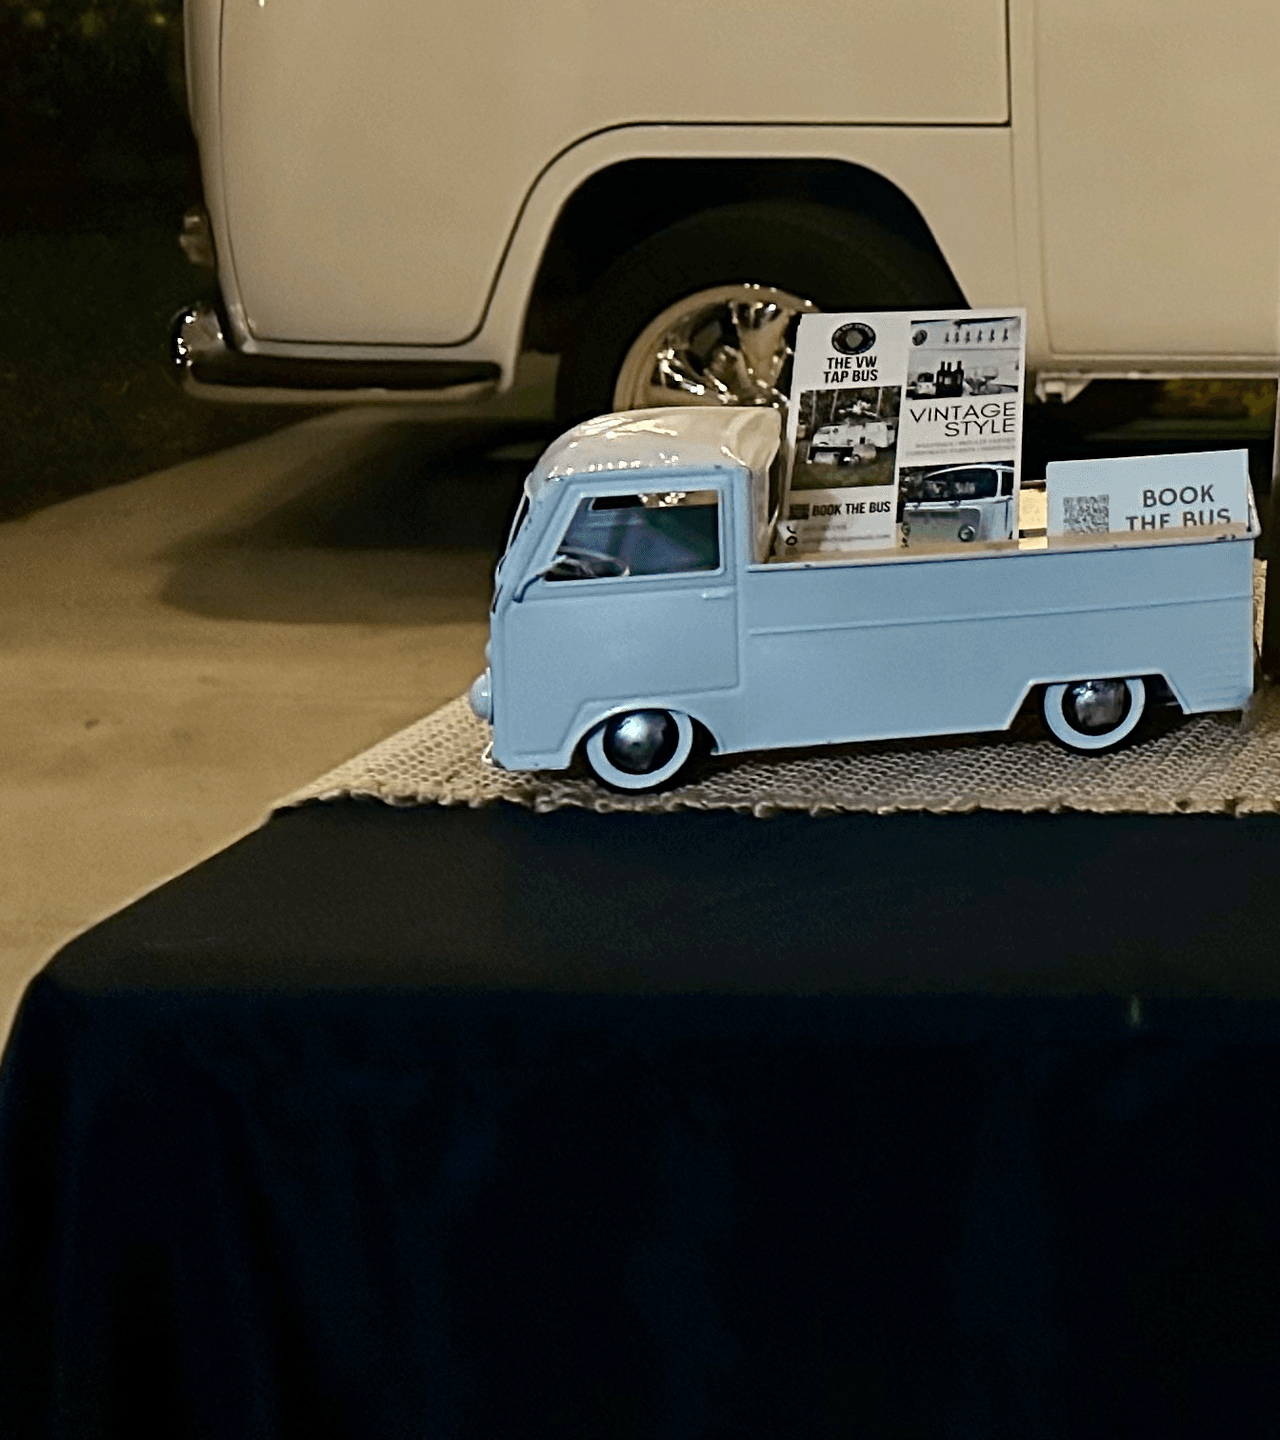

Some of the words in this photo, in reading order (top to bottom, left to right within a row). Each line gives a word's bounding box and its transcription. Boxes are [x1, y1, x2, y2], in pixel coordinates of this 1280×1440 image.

[827, 357, 852, 370] THE
[855, 356, 877, 368] VW
[823, 371, 848, 383] TAP
[852, 369, 879, 382] BUS
[909, 401, 1017, 423] VINTAGE
[944, 418, 1016, 437] STYLE
[1142, 484, 1215, 508] BOOK
[812, 503, 841, 517] BOOK
[845, 502, 866, 515] THE
[869, 501, 891, 513] BUS
